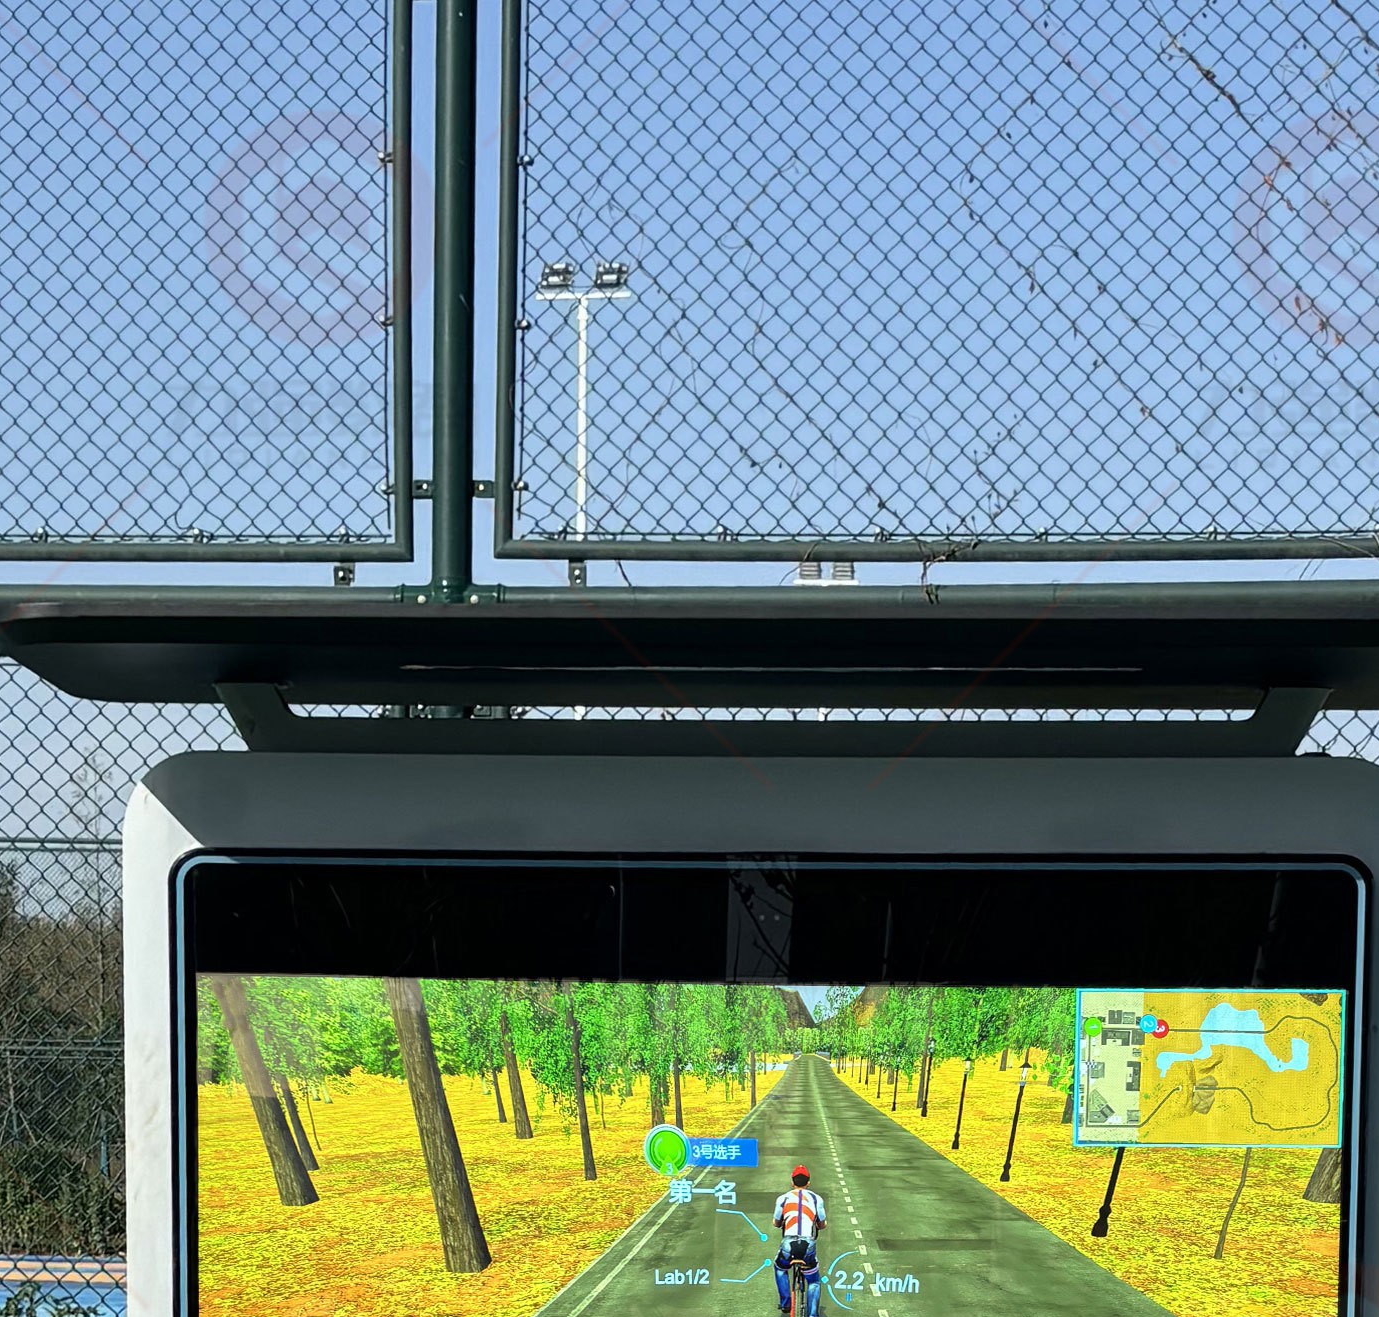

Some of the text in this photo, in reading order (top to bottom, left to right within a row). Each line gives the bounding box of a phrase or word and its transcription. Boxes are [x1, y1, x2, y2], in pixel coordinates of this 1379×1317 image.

[693, 1145, 741, 1160] 3号选手
[669, 1179, 737, 1205] 第一名
[655, 1269, 710, 1285] Lab1/2
[834, 1271, 920, 1293] 2.2 km/h
